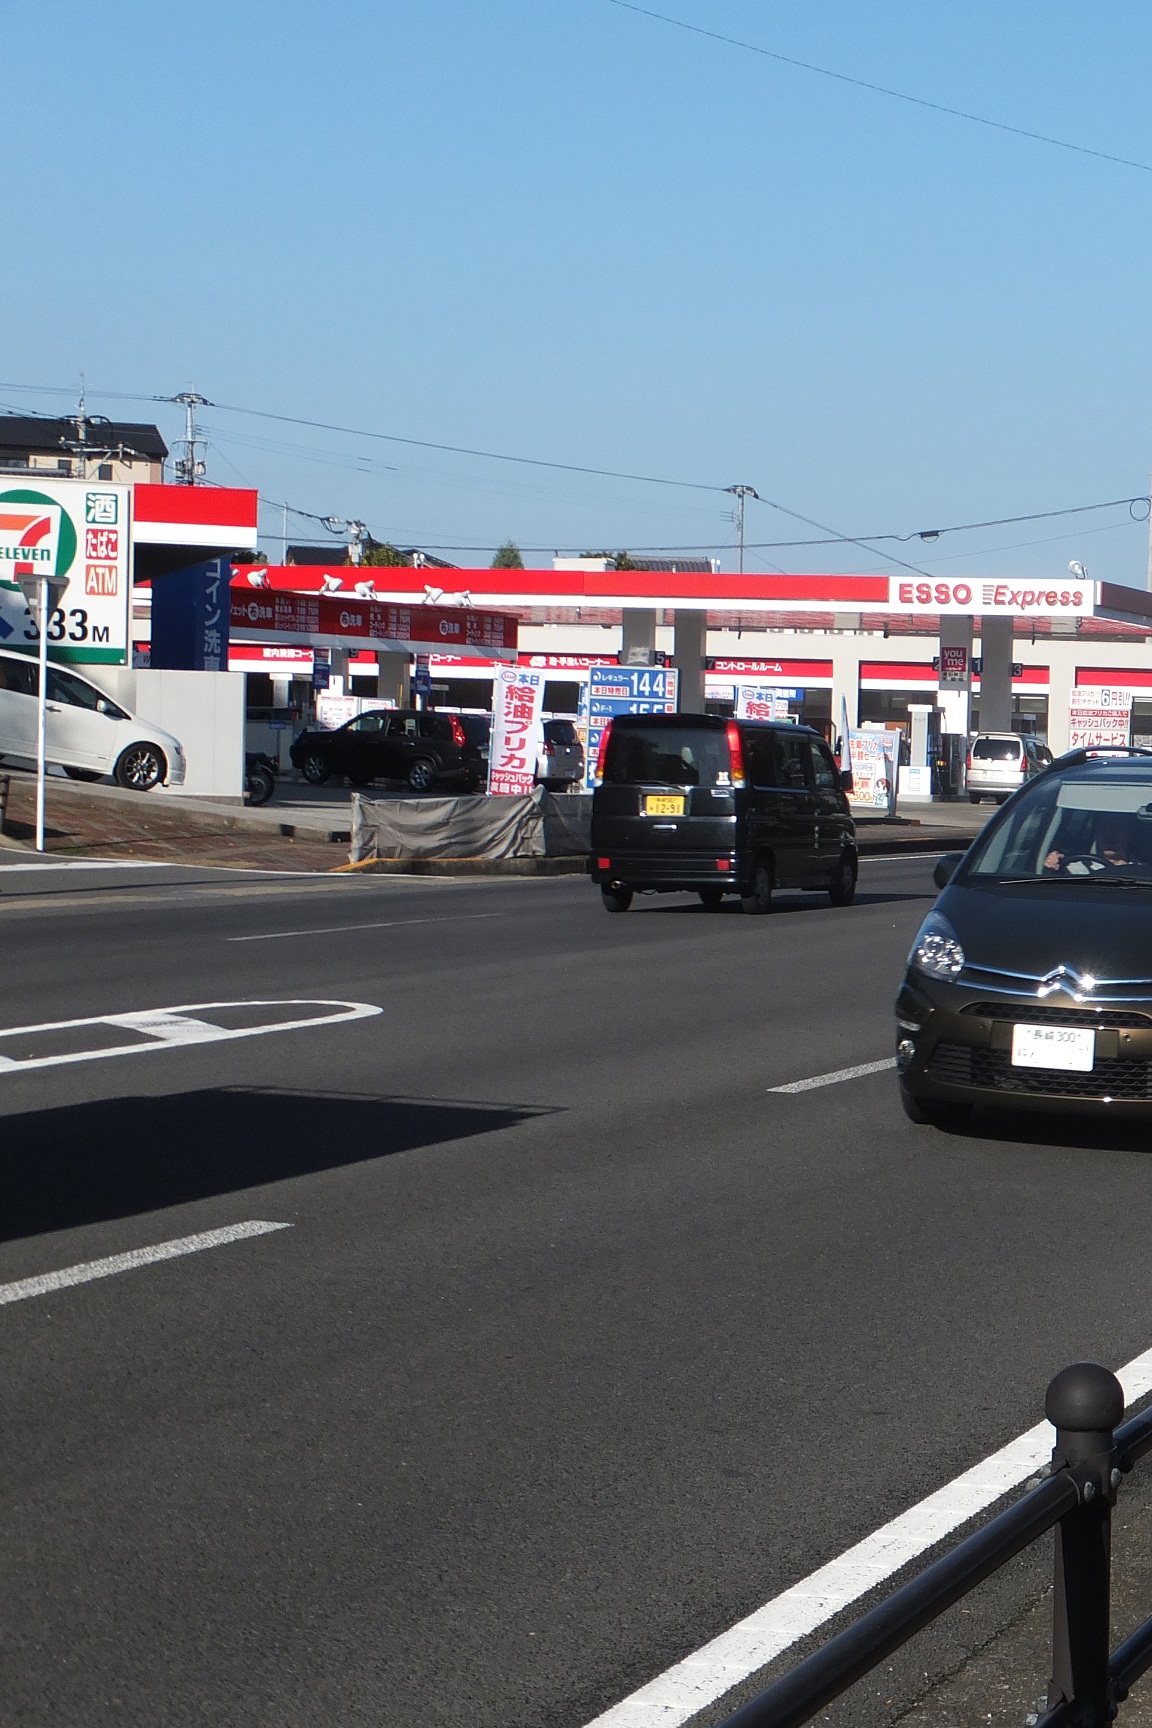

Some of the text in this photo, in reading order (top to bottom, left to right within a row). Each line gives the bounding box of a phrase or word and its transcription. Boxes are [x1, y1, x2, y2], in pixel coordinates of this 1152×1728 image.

[87, 494, 116, 523] 酒
[86, 530, 117, 558] たばこ
[87, 566, 117, 594] ATM
[899, 583, 1083, 610] ESSO Express
[944, 650, 963, 660] you
[715, 661, 782, 672] コントロールルーム
[1013, 665, 1022, 676] 3
[519, 673, 539, 686] 本日
[631, 672, 664, 697] 144
[594, 687, 628, 695] 本日特売日
[756, 692, 773, 702] 本日
[500, 684, 536, 769] 給油プリカ
[1072, 732, 1126, 747] タイムサービス
[491, 772, 534, 784] キャッシュバック
